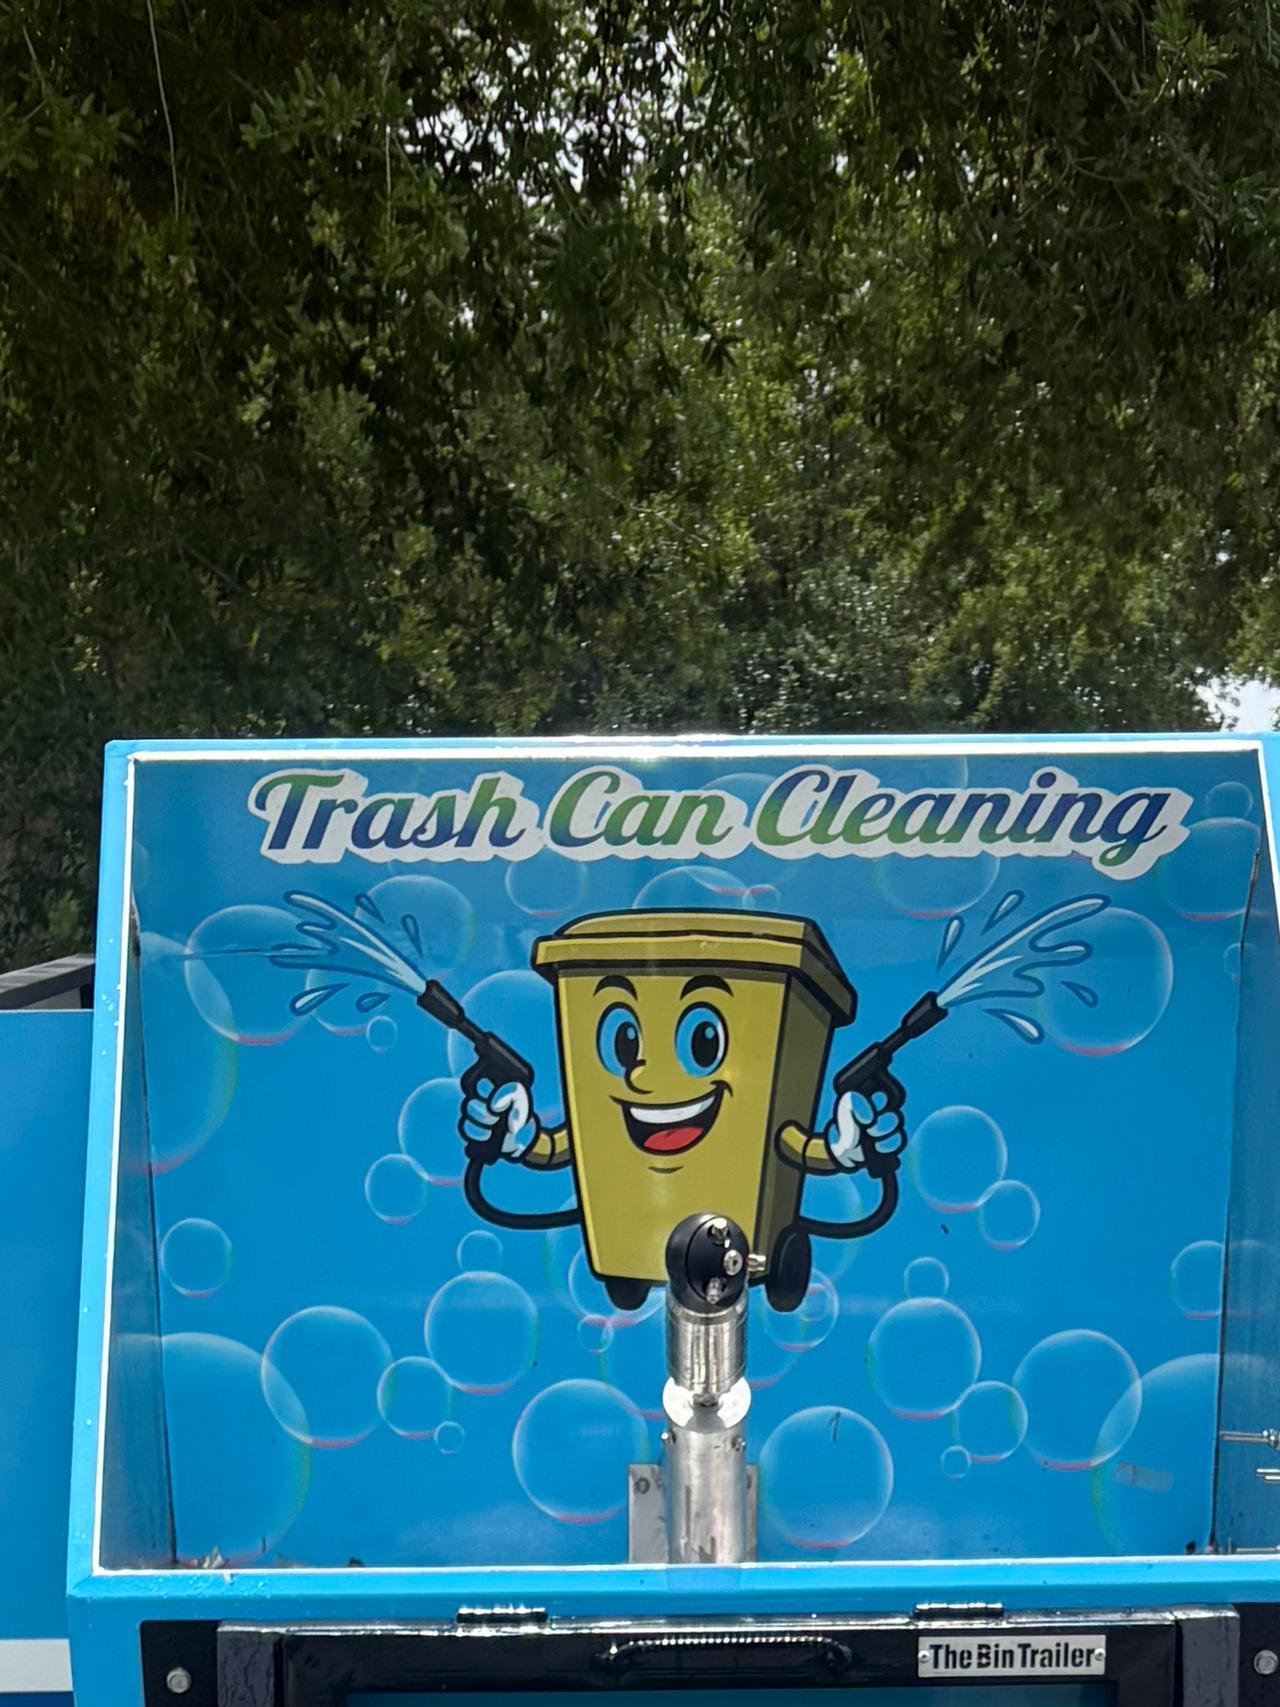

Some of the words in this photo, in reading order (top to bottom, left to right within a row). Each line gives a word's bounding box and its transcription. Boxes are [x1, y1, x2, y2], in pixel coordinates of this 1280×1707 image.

[255, 772, 527, 850] Trash
[548, 770, 734, 849] Can
[755, 768, 1170, 867] Cleaning
[929, 1643, 973, 1669] The
[976, 1643, 1015, 1669] Bin
[1017, 1641, 1096, 1668] Trailer
